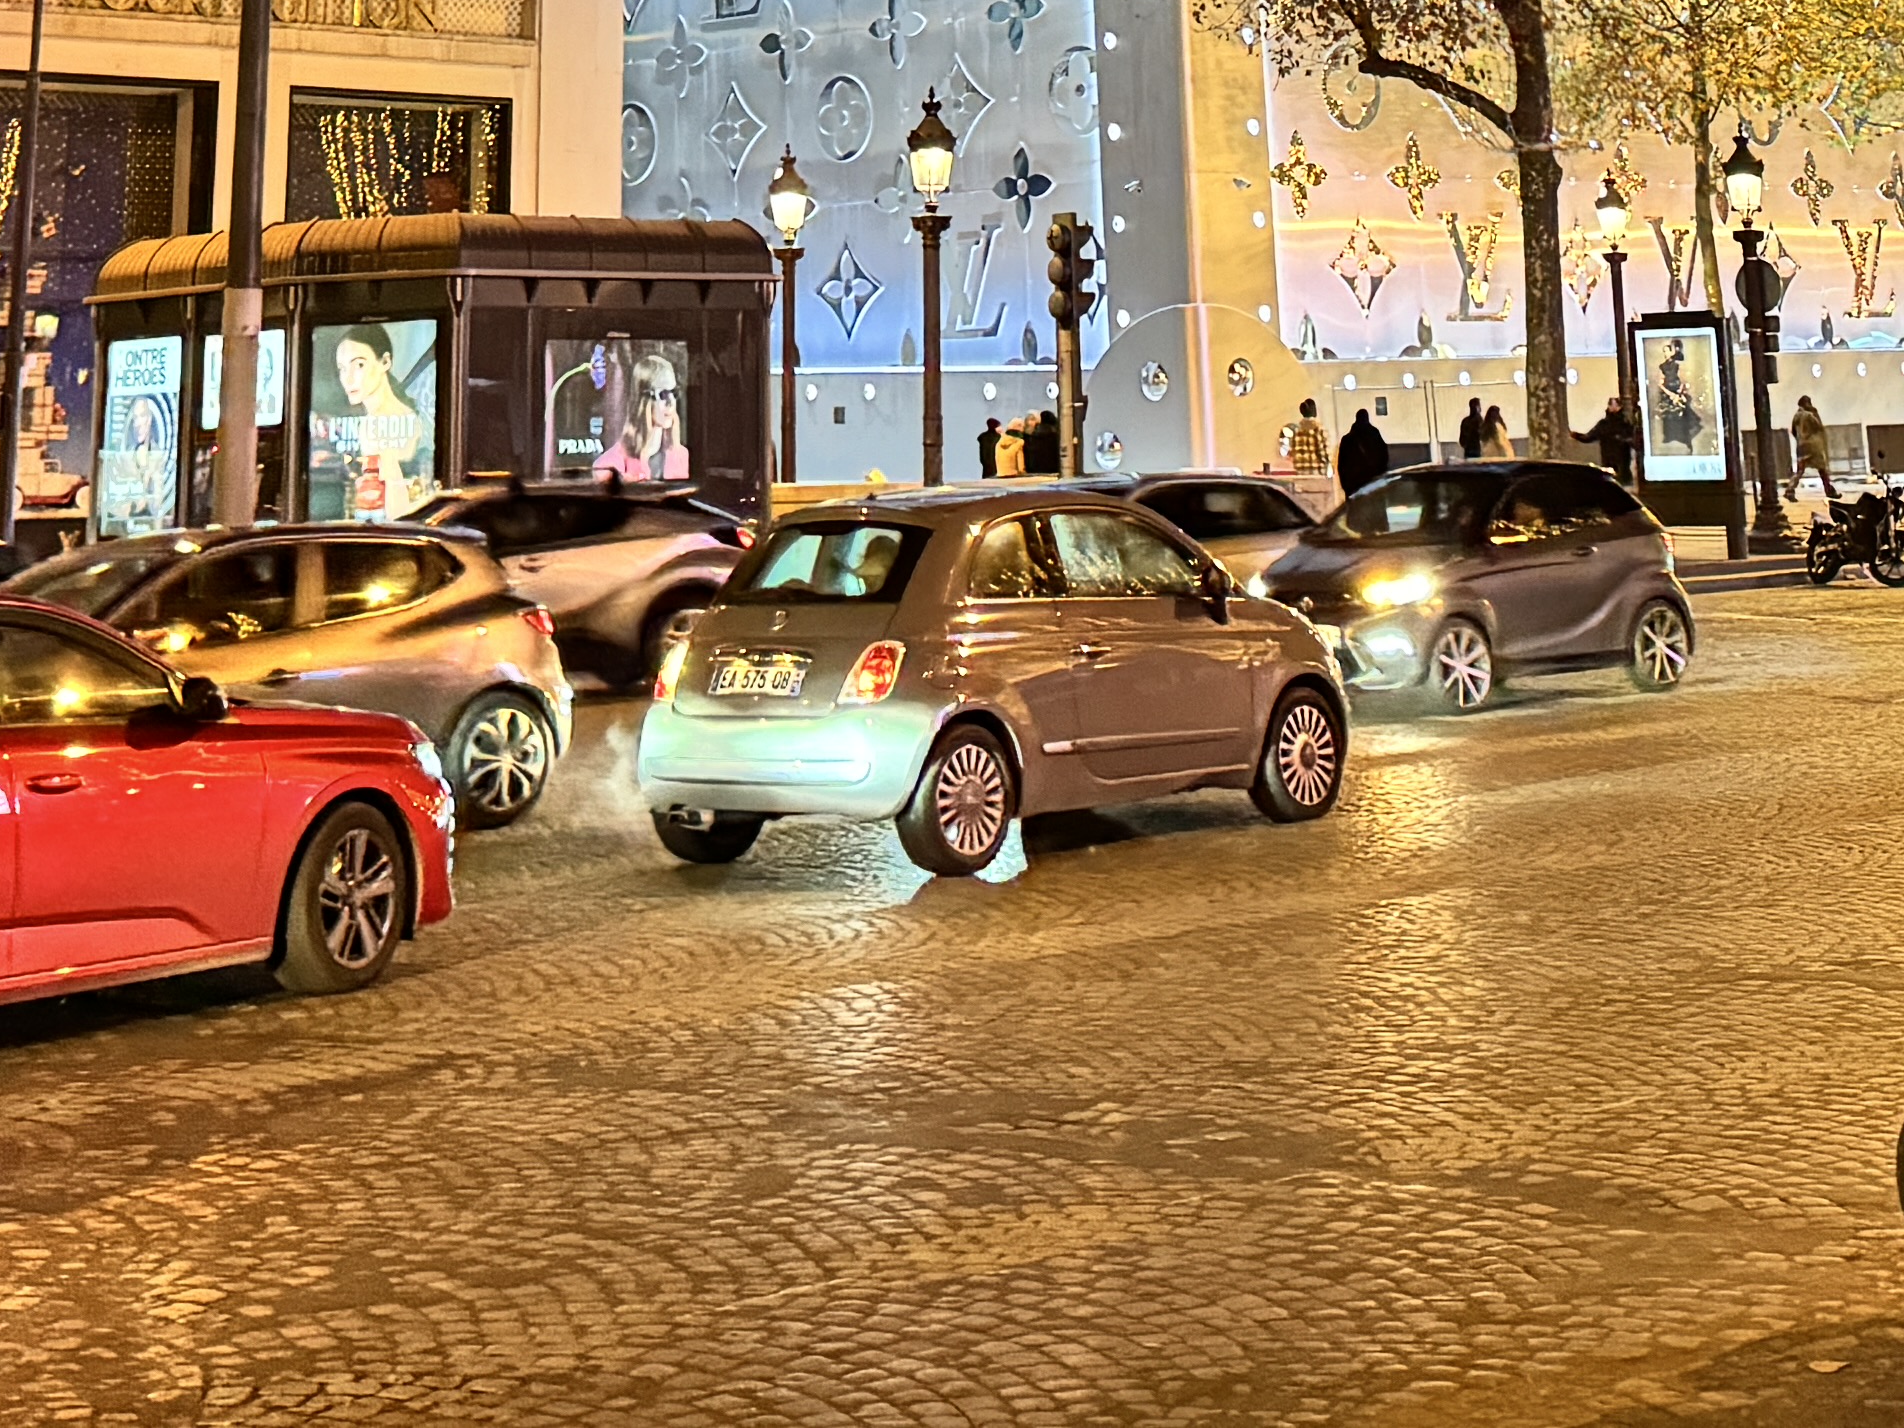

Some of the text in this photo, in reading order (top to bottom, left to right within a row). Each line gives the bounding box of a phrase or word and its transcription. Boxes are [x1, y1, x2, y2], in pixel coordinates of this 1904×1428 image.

[1437, 211, 1513, 322] LV
[1831, 218, 1897, 319] LV
[120, 347, 168, 369] ONTRE
[328, 414, 417, 443] L'INTERDIT
[558, 438, 604, 454] PRADA
